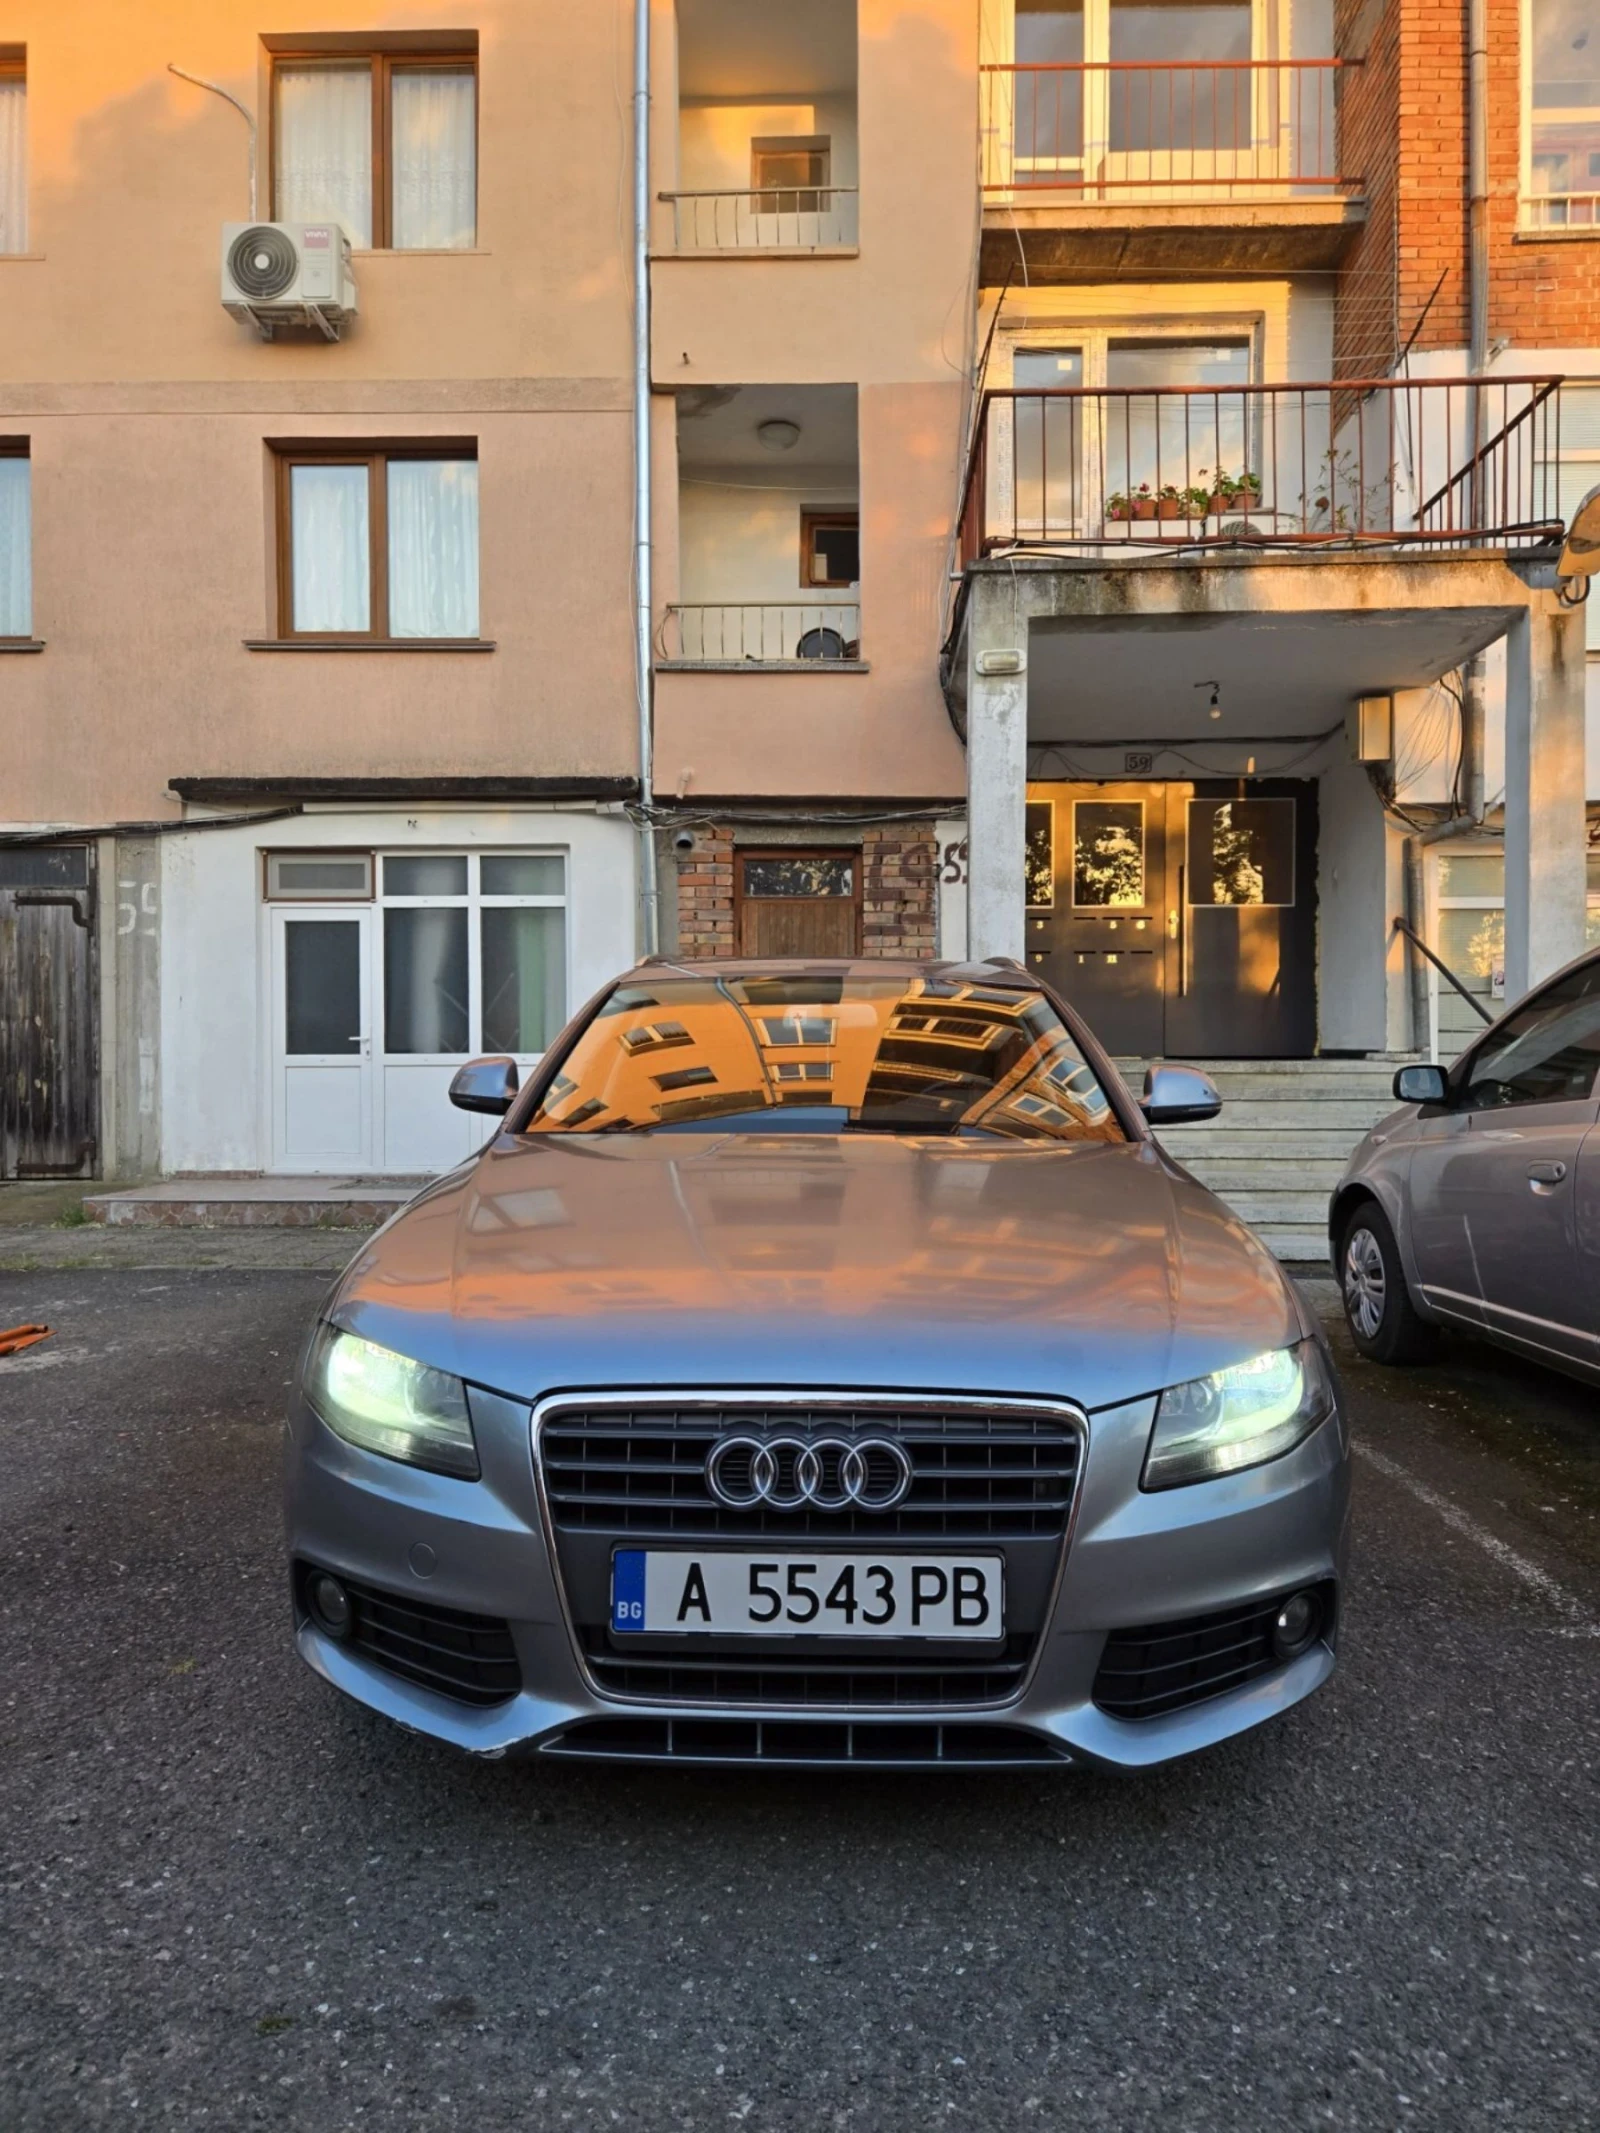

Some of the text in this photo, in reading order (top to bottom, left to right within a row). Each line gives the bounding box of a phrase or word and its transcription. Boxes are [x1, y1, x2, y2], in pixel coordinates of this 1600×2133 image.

[1129, 756, 1148, 770] 59
[676, 1562, 990, 1627] A 5543 PB
[617, 1601, 642, 1619] BG
